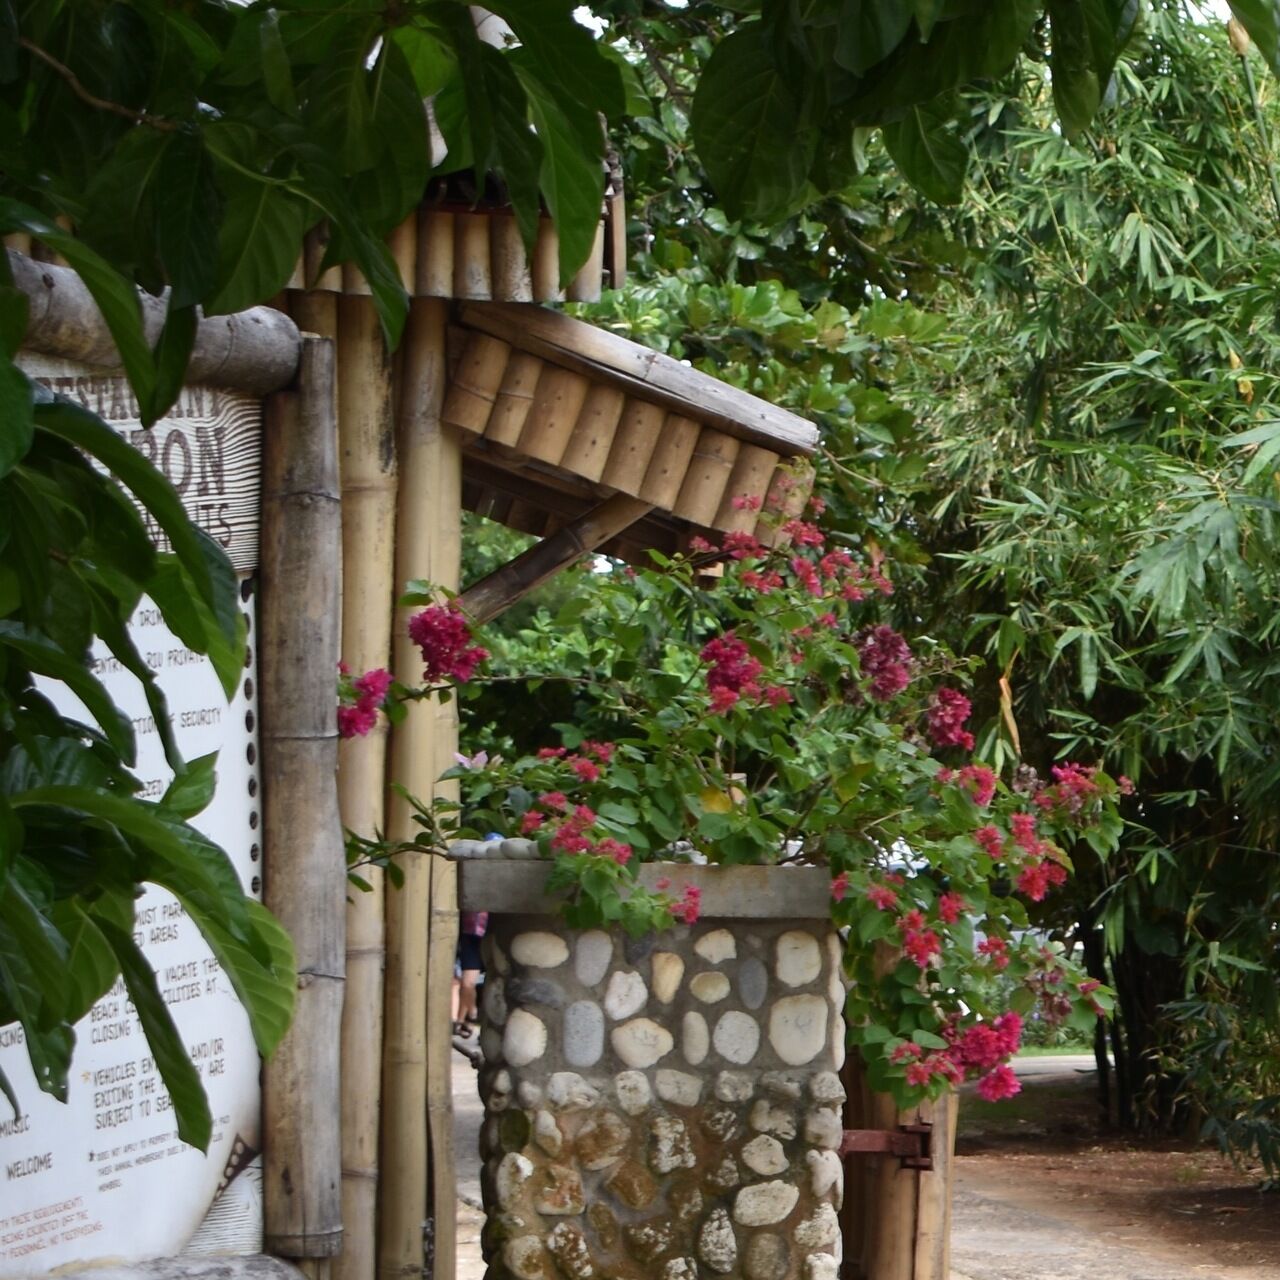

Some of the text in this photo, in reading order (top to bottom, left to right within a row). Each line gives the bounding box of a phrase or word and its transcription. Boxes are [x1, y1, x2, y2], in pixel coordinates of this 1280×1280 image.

[181, 707, 221, 728] SECURITY
[151, 924, 178, 945] AREAS
[165, 961, 197, 984] VACATE
[203, 957, 220, 975] THE
[91, 1001, 120, 1022] BEACH
[207, 977, 217, 994] AT
[92, 1019, 130, 1044] CLOSING
[94, 1060, 136, 1087] VEHICLES
[191, 1037, 224, 1060] AND/OR
[95, 1082, 134, 1109] EXITING
[139, 1076, 156, 1096] THE
[209, 1058, 225, 1077] ARE
[96, 1103, 133, 1130] SUBJECT
[139, 1098, 152, 1119] TO
[7, 1152, 53, 1182] WELCOME
